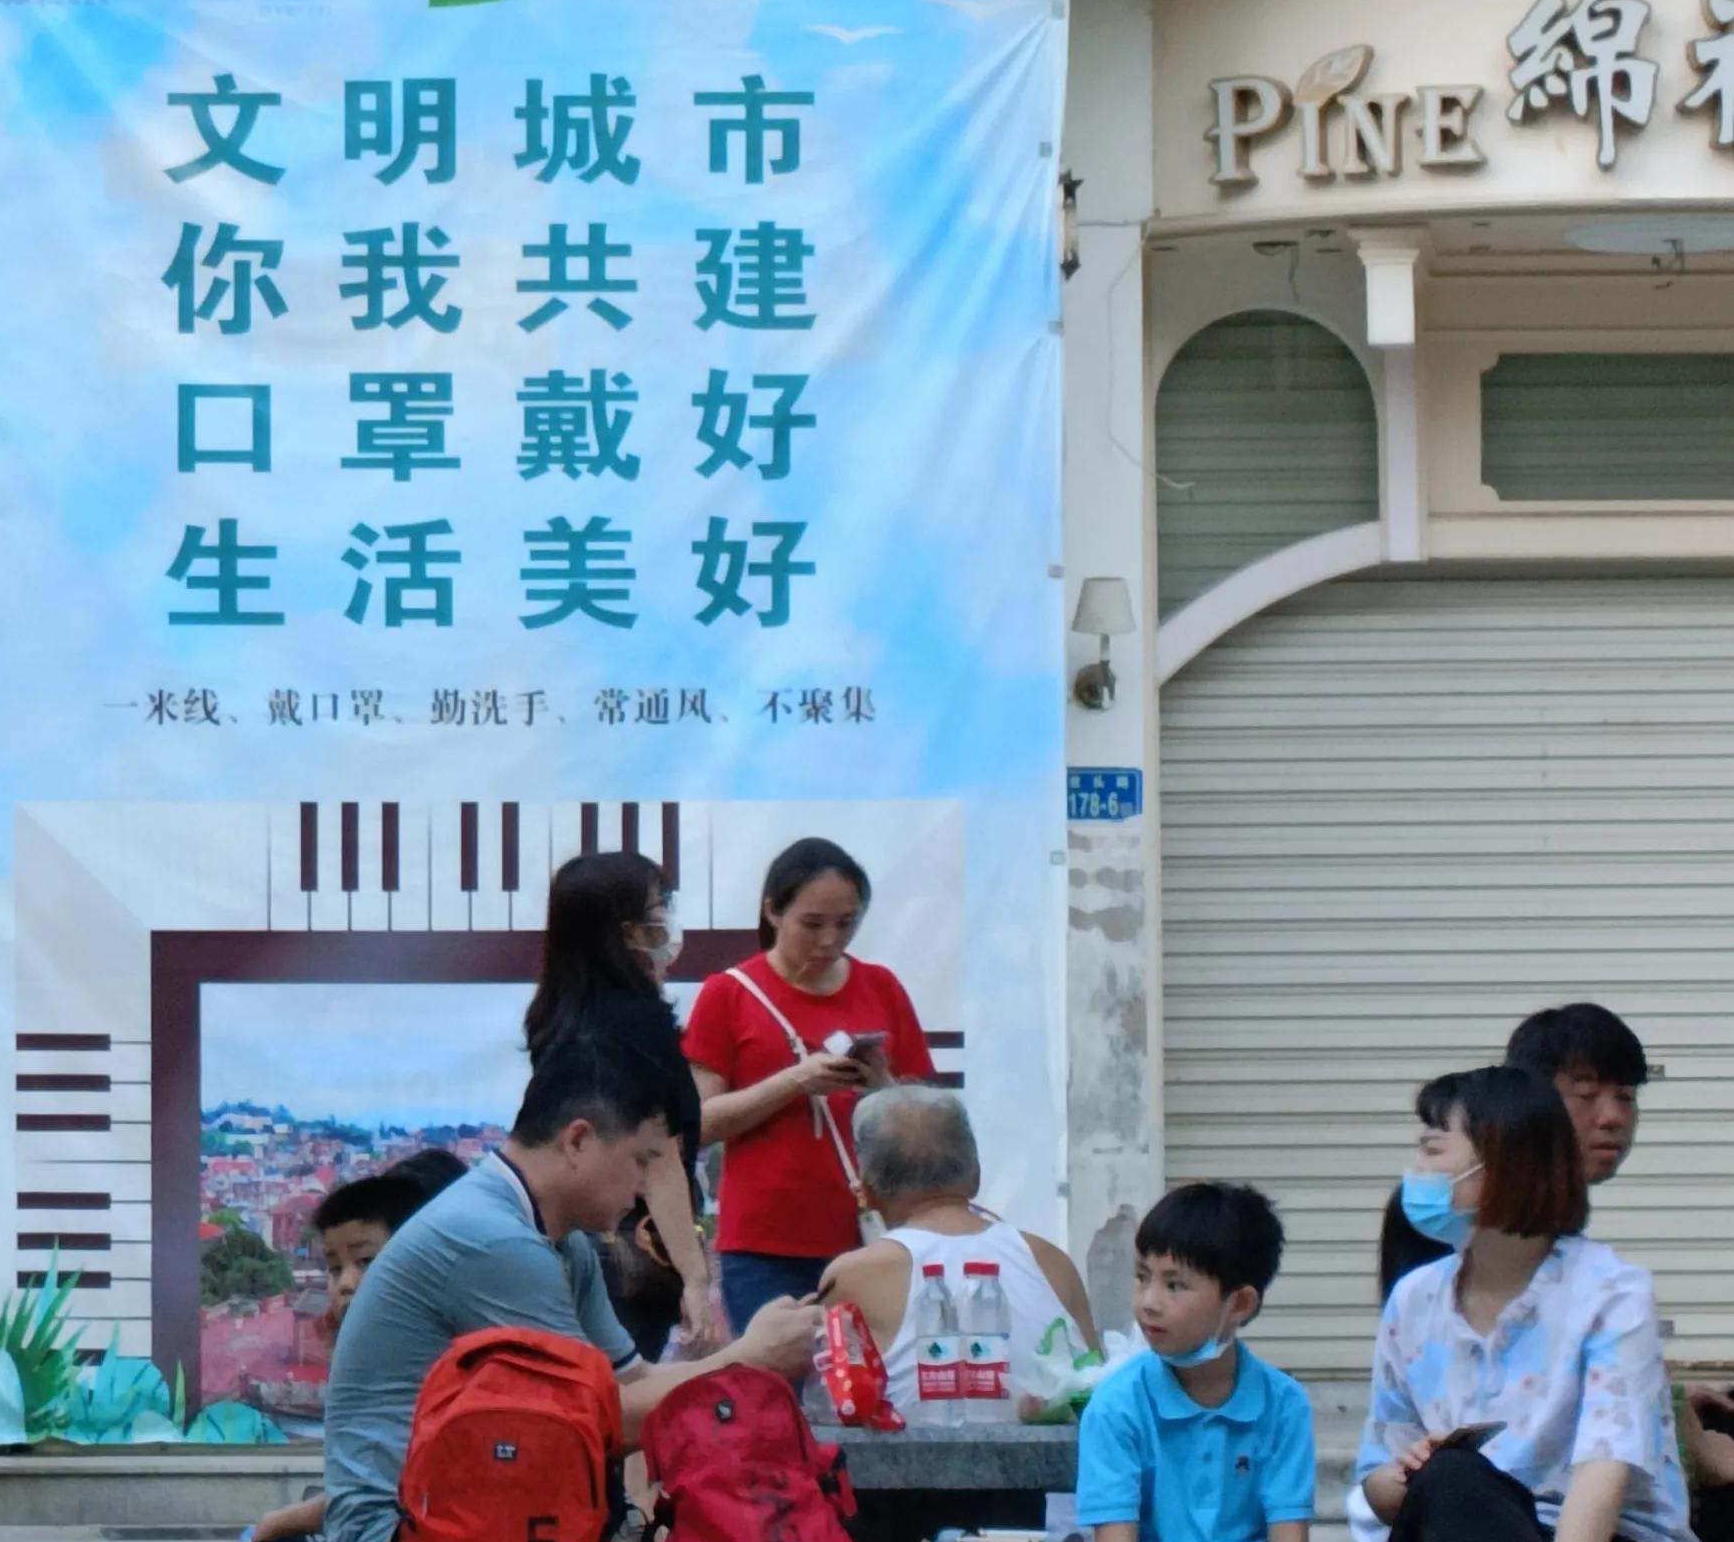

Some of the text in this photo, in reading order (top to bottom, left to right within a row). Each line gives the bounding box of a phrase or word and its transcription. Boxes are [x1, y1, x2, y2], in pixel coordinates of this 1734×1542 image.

[163, 73, 816, 186] 文明城市
[1204, 71, 1485, 184] PINE
[162, 221, 816, 335] 你我共建
[176, 369, 817, 482] 口罩戴好
[166, 515, 816, 630] 生活美好
